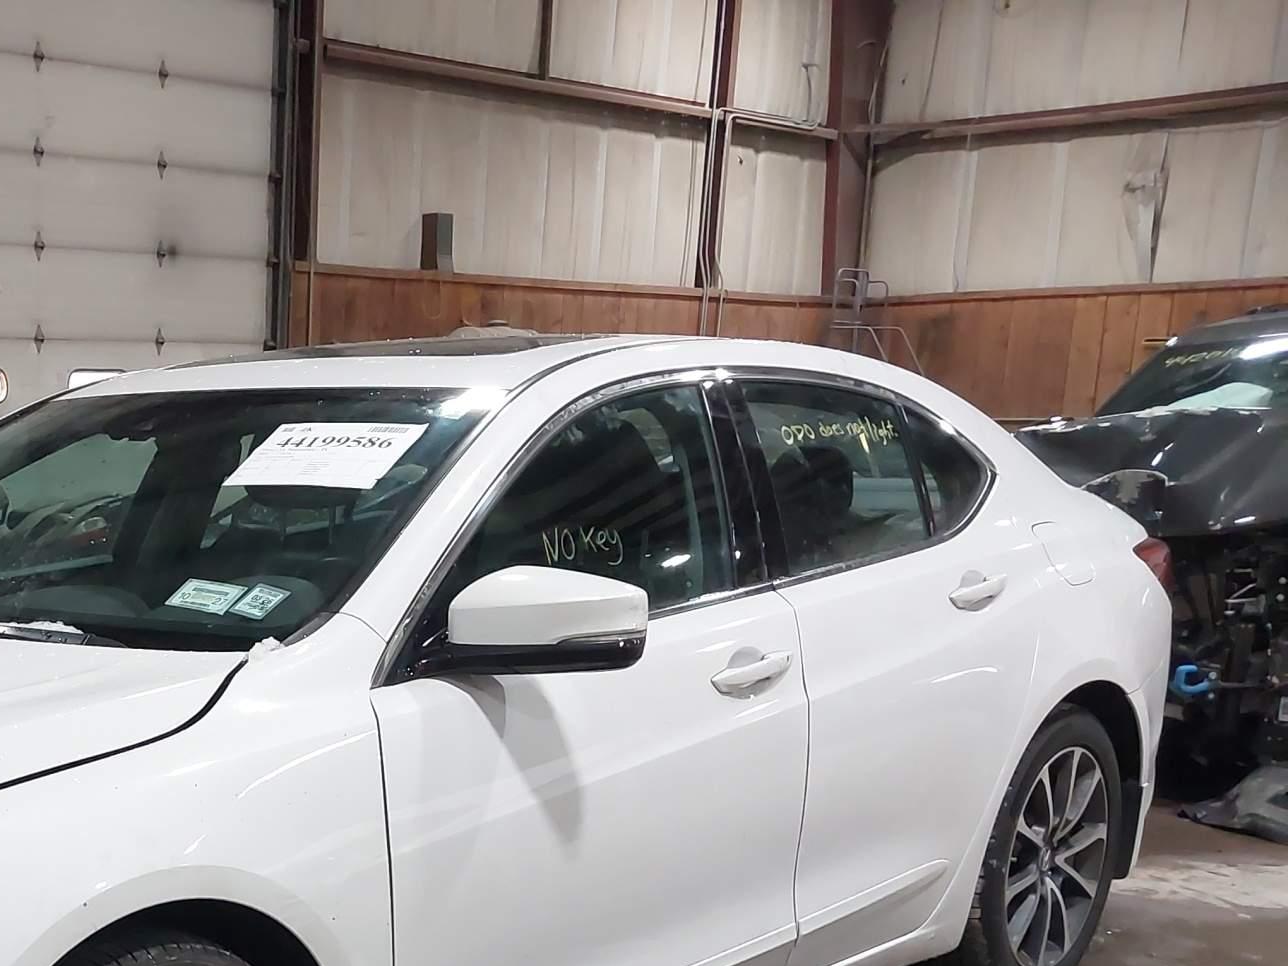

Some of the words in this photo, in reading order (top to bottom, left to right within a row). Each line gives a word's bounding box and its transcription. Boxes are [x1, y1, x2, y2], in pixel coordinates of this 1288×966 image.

[276, 436, 396, 449] 44199586
[781, 423, 816, 446] ODO
[542, 527, 576, 566] NO
[578, 526, 624, 566] Key
